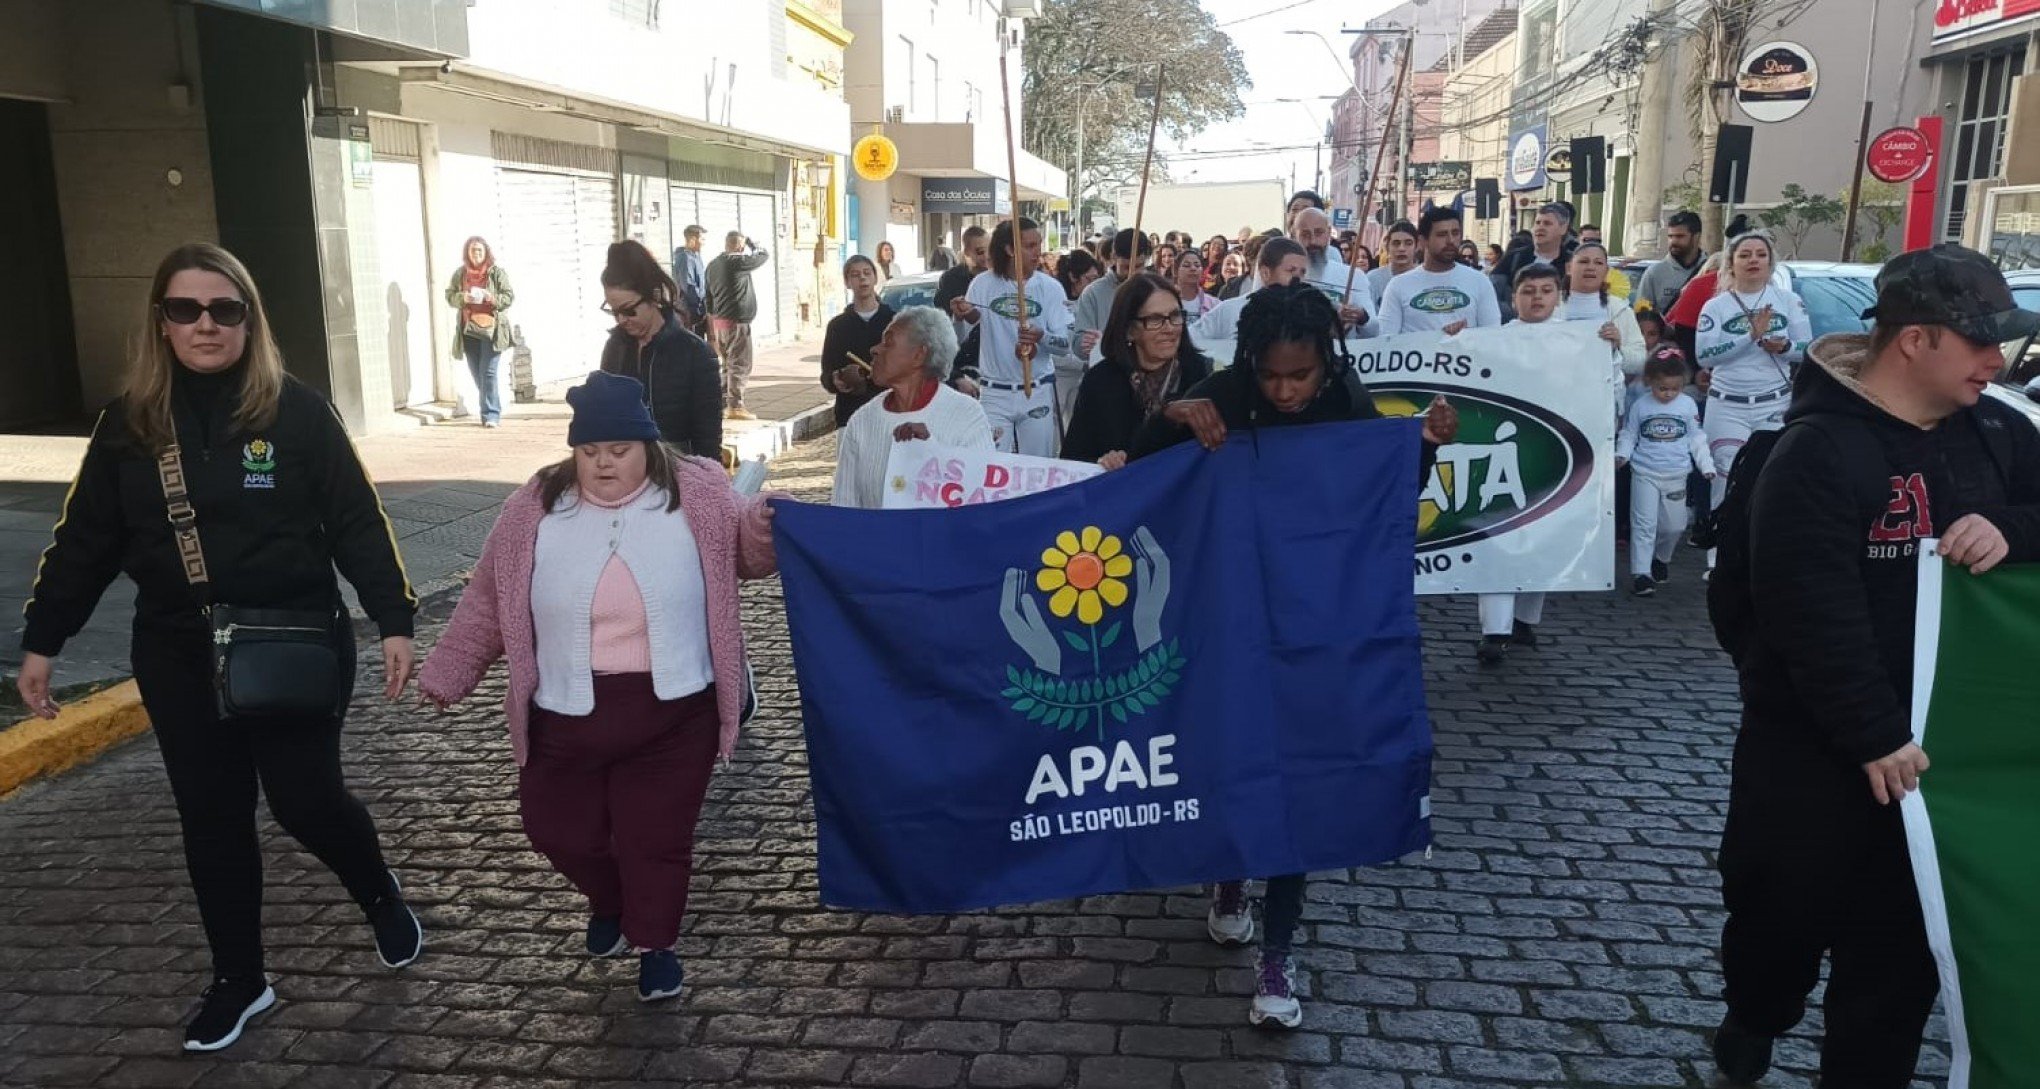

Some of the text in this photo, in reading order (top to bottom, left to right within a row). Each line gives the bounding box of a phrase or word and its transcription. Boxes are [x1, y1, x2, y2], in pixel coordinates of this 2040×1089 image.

[1882, 141, 1917, 151] CÂMBIO
[925, 189, 946, 199] Casa
[947, 190, 962, 199] dos
[243, 473, 275, 484] APAE
[918, 457, 965, 481] AS
[1869, 473, 1934, 541] 21
[1867, 544, 1898, 559] BIO
[1025, 733, 1179, 804] APAE
[1010, 813, 1051, 842] SÃO
